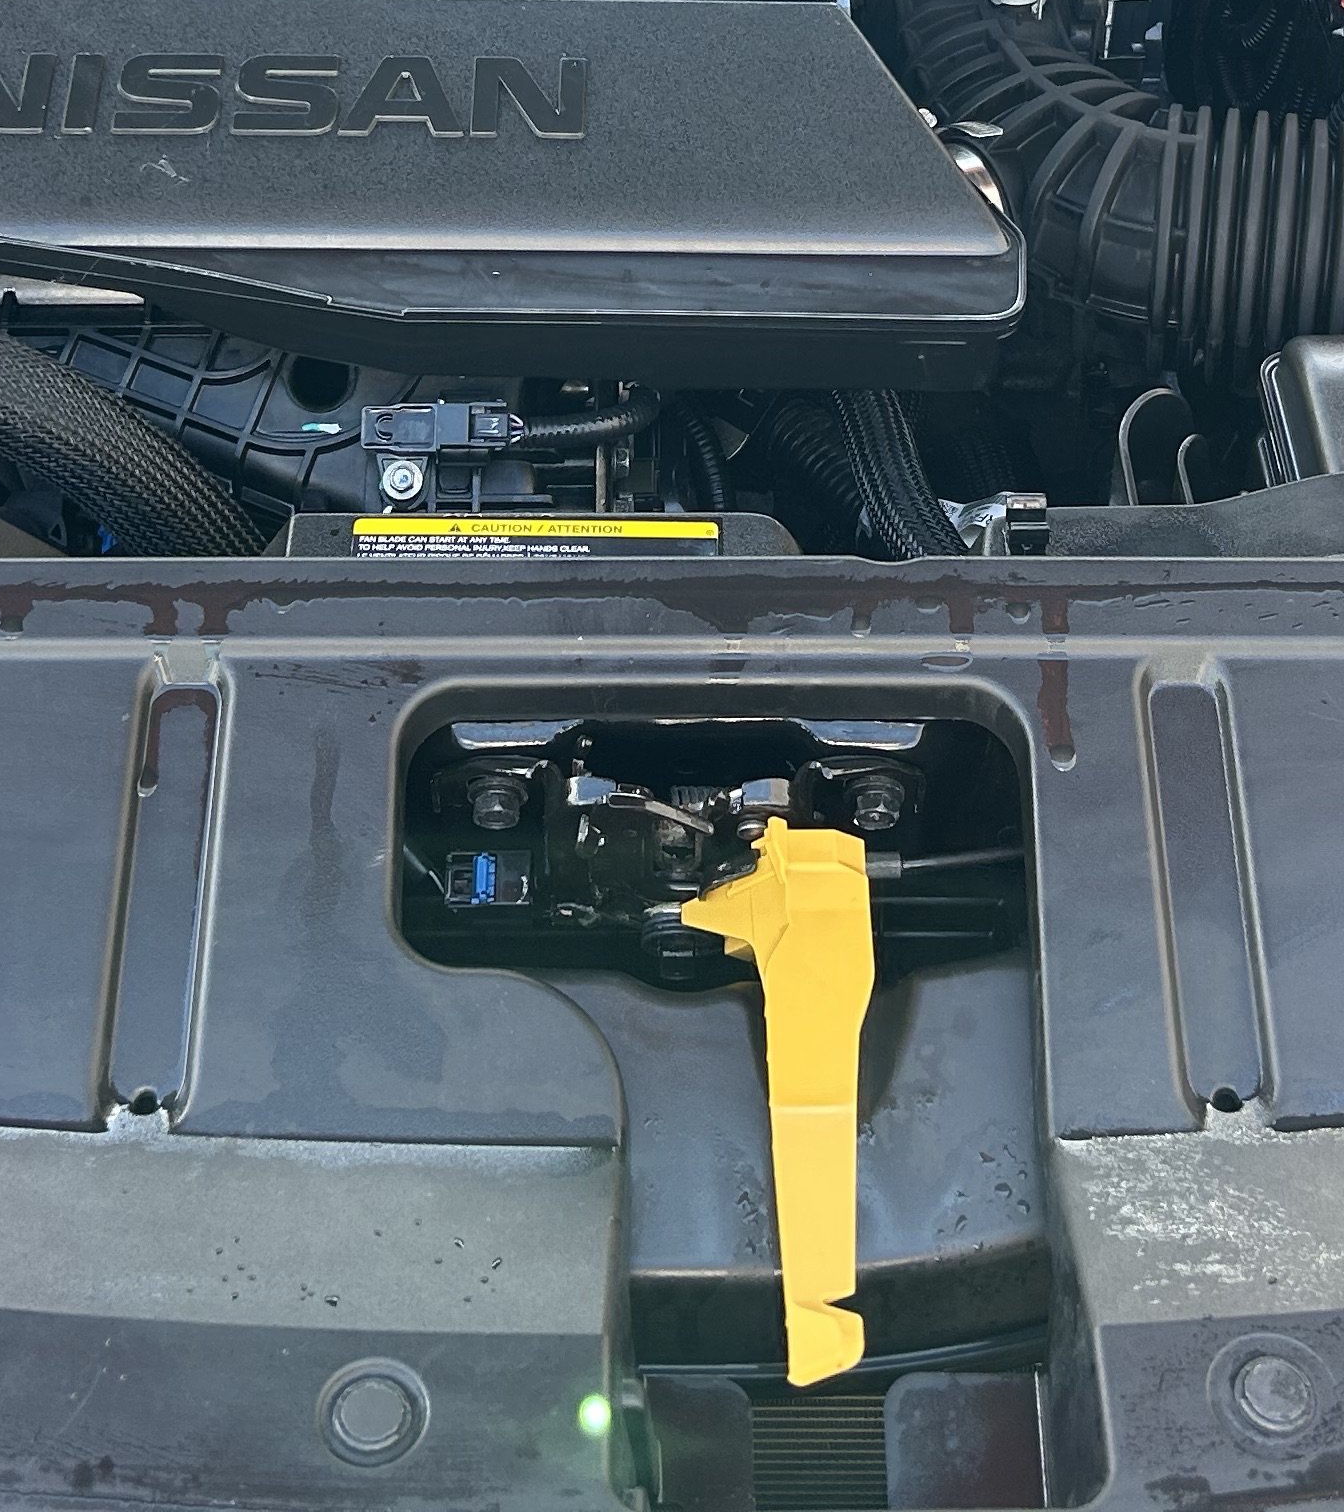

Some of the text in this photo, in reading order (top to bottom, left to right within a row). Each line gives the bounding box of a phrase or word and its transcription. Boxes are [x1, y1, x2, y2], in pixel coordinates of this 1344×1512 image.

[471, 523, 623, 534] CAUTION / ATTENTION
[469, 536, 487, 544] ANY
[396, 544, 424, 552] AVOID
[424, 544, 471, 552] PERSONAL
